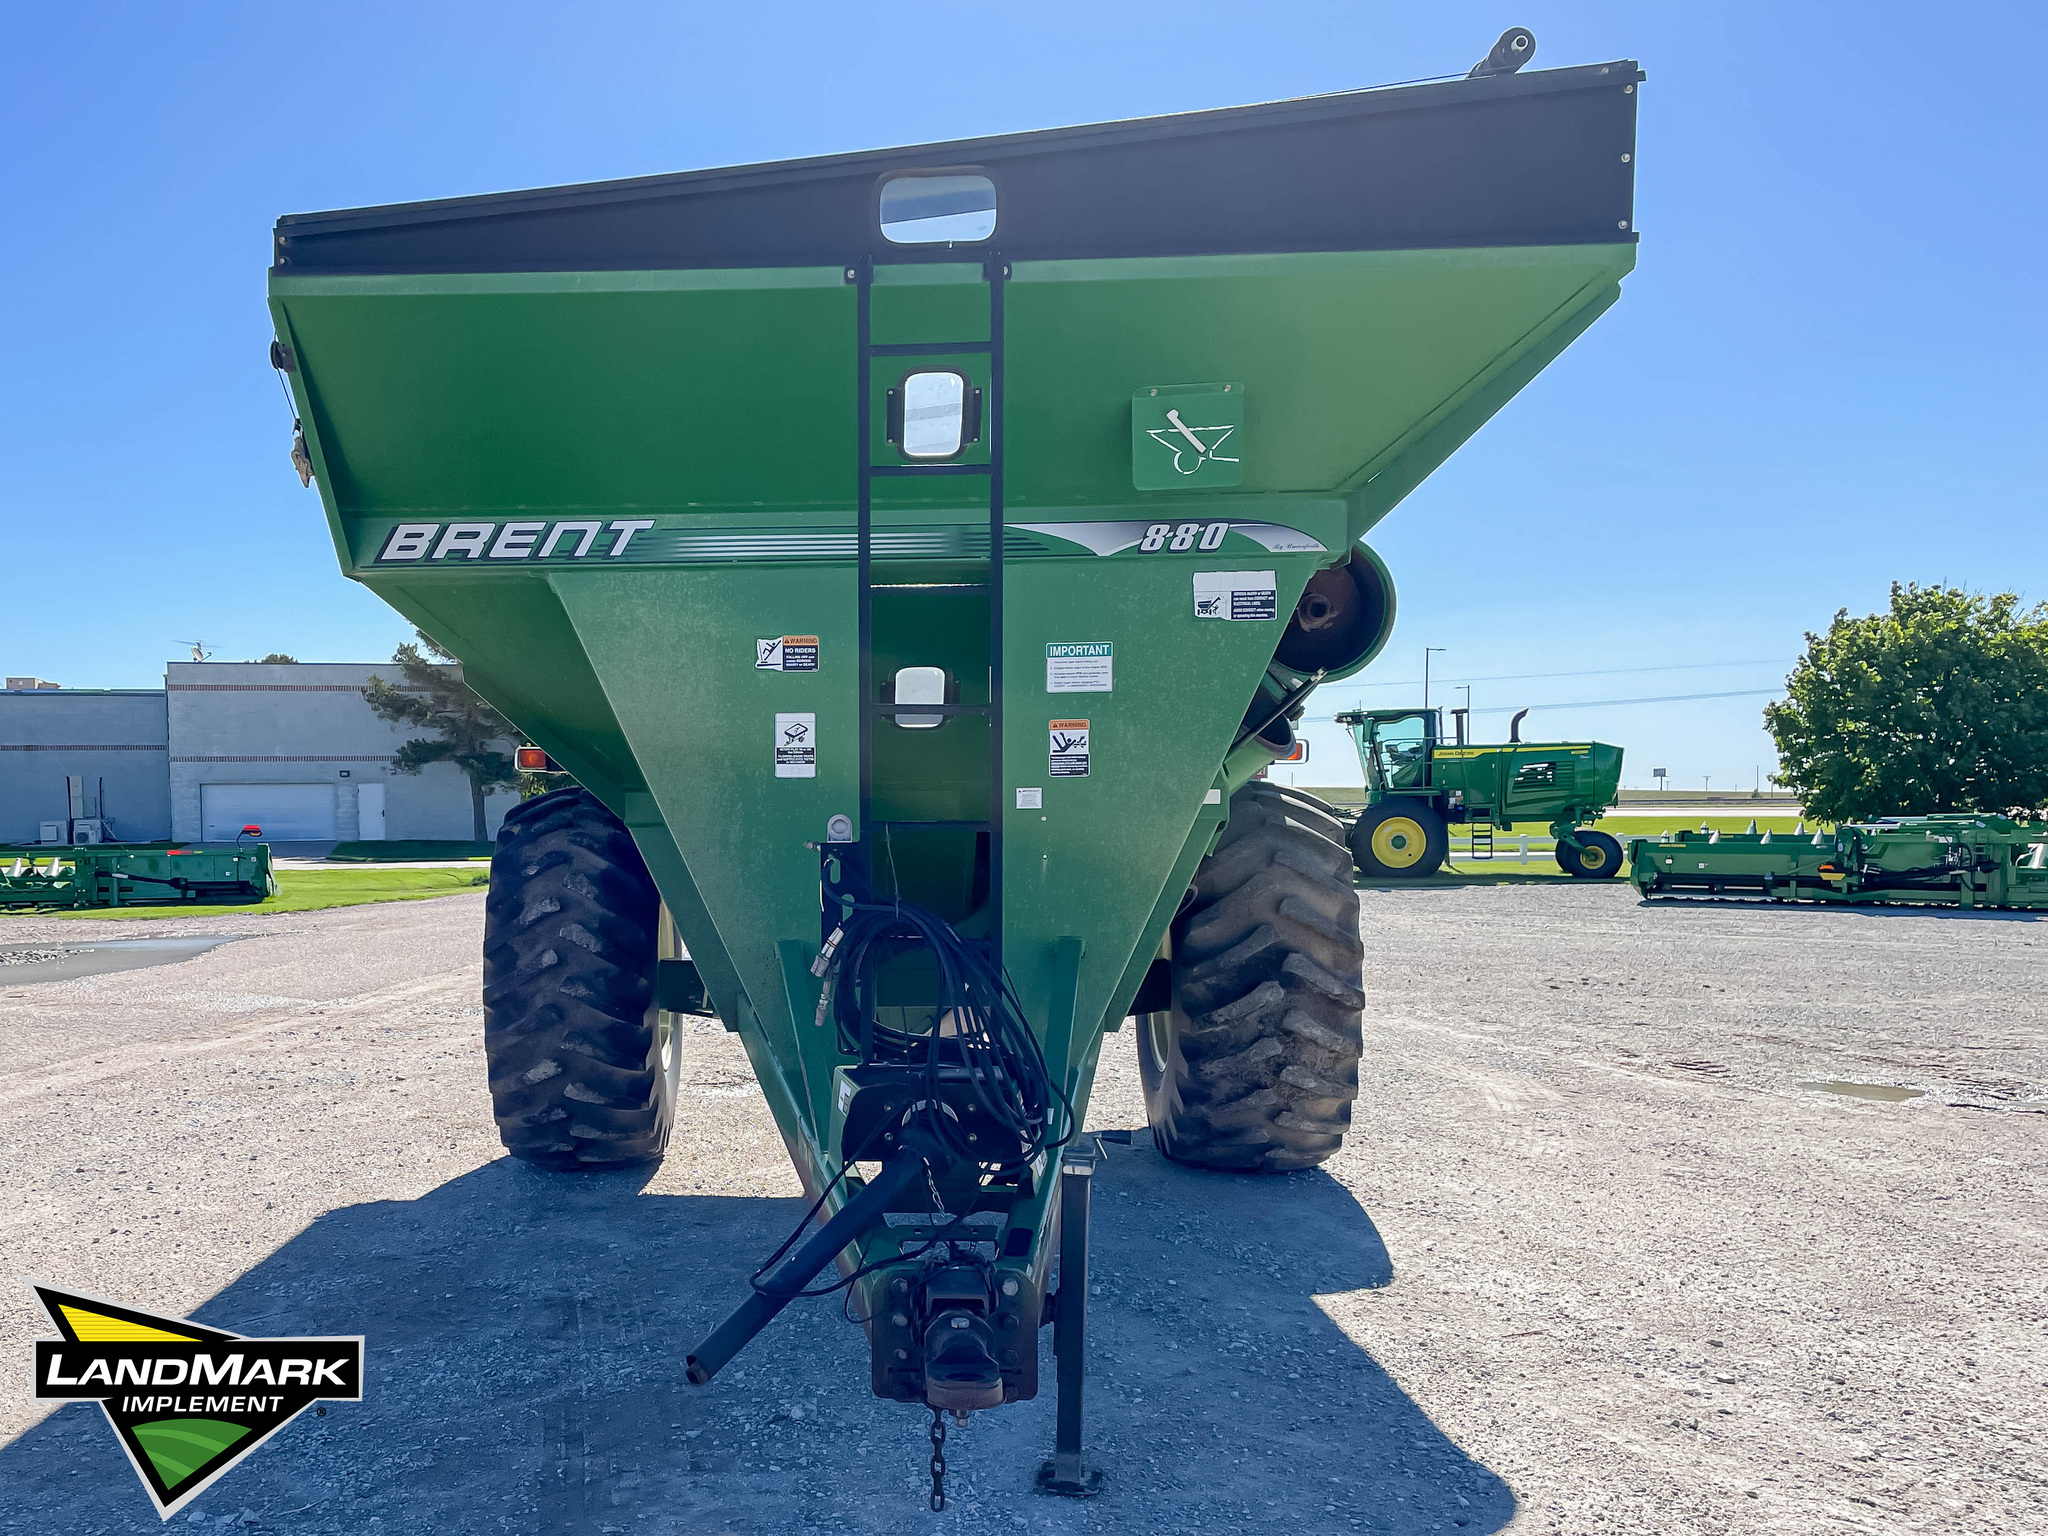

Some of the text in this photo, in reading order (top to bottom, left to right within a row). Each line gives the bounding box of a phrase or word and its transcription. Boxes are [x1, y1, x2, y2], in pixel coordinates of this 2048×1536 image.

[373, 519, 657, 564] BRENT
[1138, 522, 1230, 554] 880
[1050, 644, 1109, 656] IMPORTANT
